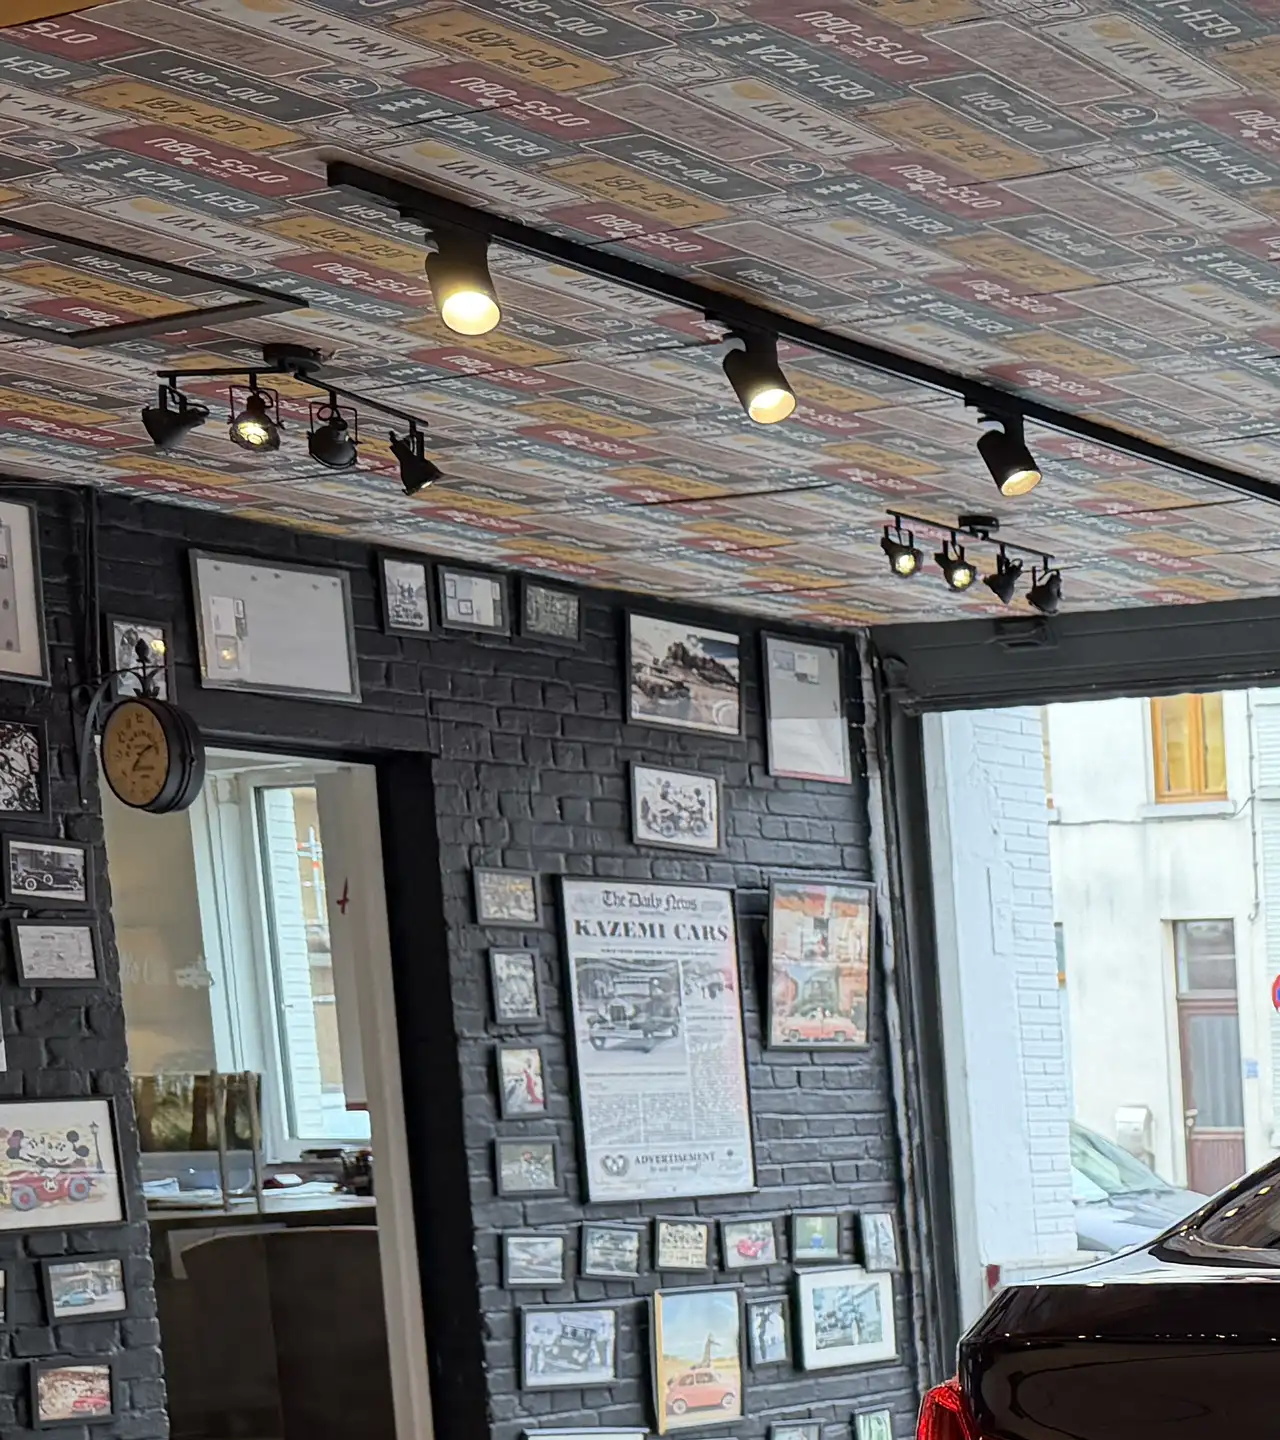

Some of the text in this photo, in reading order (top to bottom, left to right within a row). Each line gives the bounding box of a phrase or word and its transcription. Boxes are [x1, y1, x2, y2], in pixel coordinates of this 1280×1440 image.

[601, 890, 699, 912] The Daily News
[573, 919, 729, 942] KAZEMI CARS
